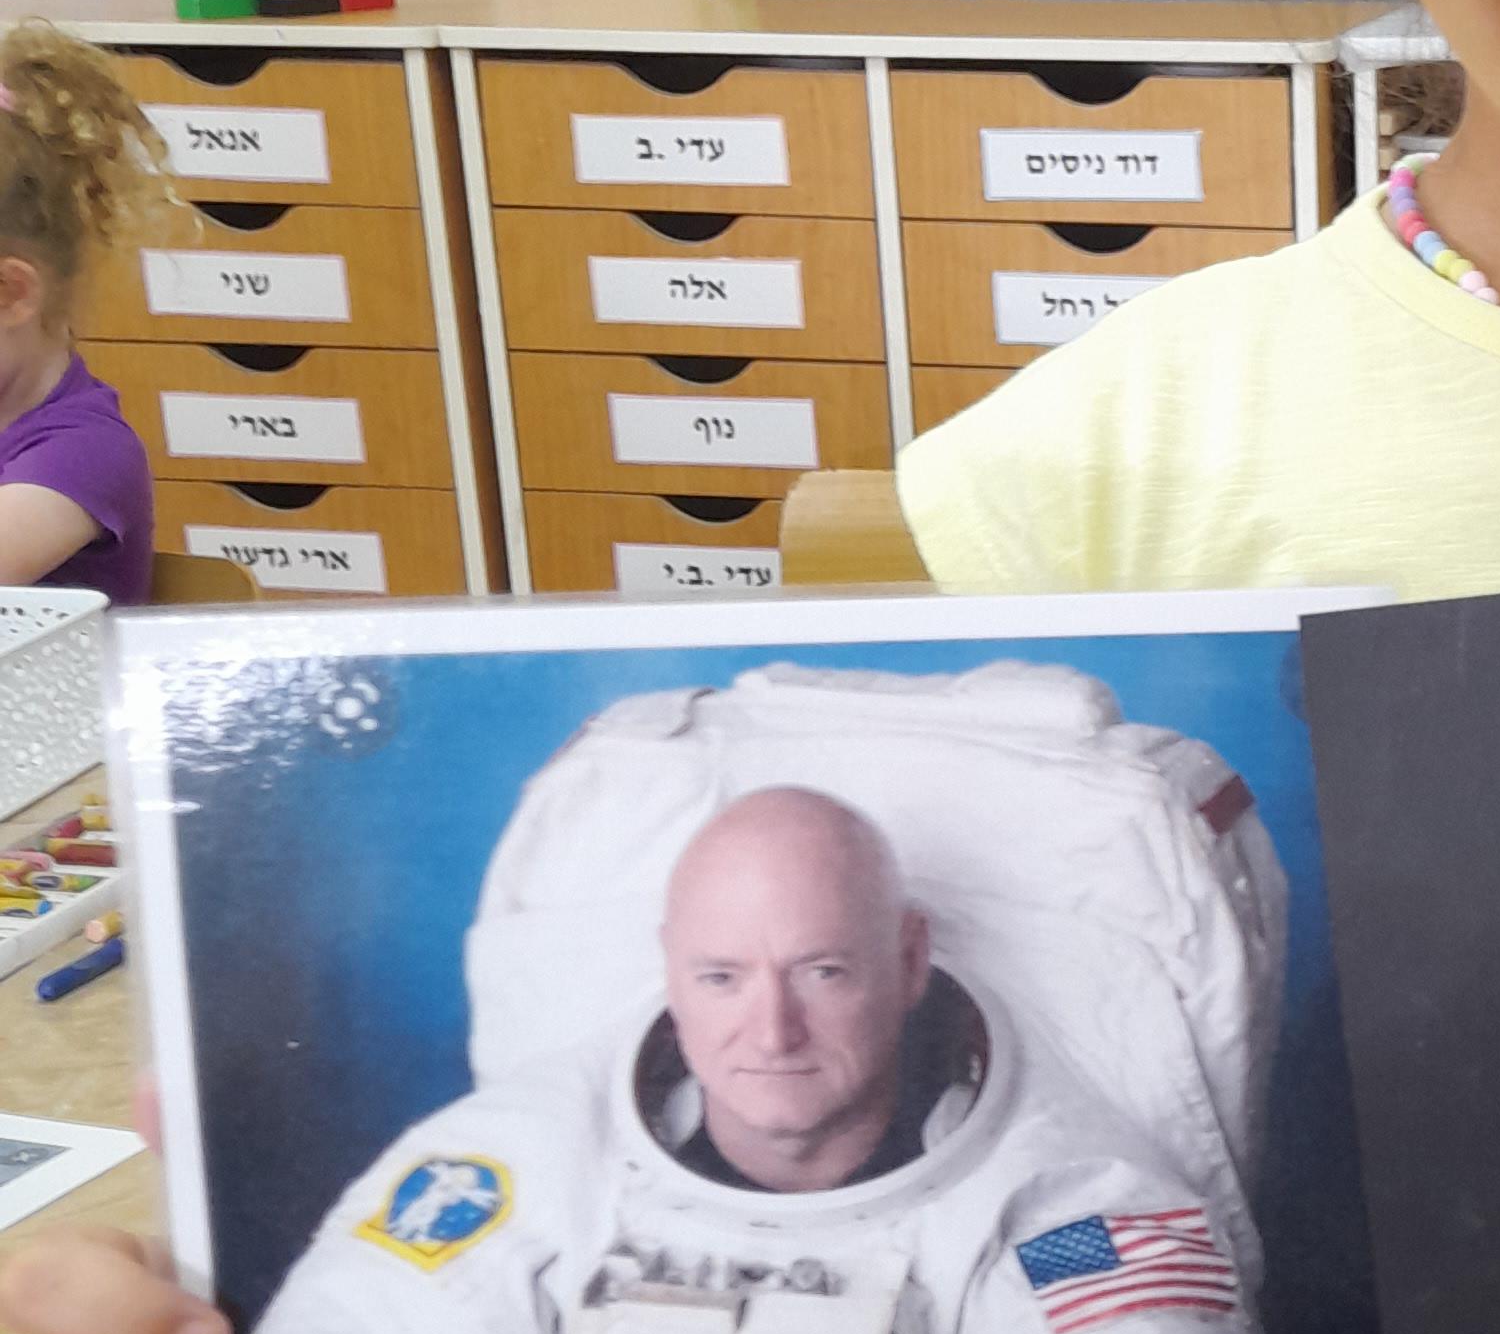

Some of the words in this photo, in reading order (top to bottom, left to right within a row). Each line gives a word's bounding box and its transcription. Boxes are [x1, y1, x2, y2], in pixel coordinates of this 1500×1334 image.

[186, 122, 261, 152] אנאל
[675, 137, 725, 163] עדי
[1025, 153, 1105, 175] ניסים
[1115, 154, 1159, 174] דוד
[220, 272, 270, 296] שני
[667, 275, 728, 300] אלה
[1041, 291, 1095, 317] רחל
[228, 413, 298, 438] בארי
[693, 417, 735, 444] נוף
[298, 548, 351, 571] ארי
[724, 563, 772, 587] עדי
